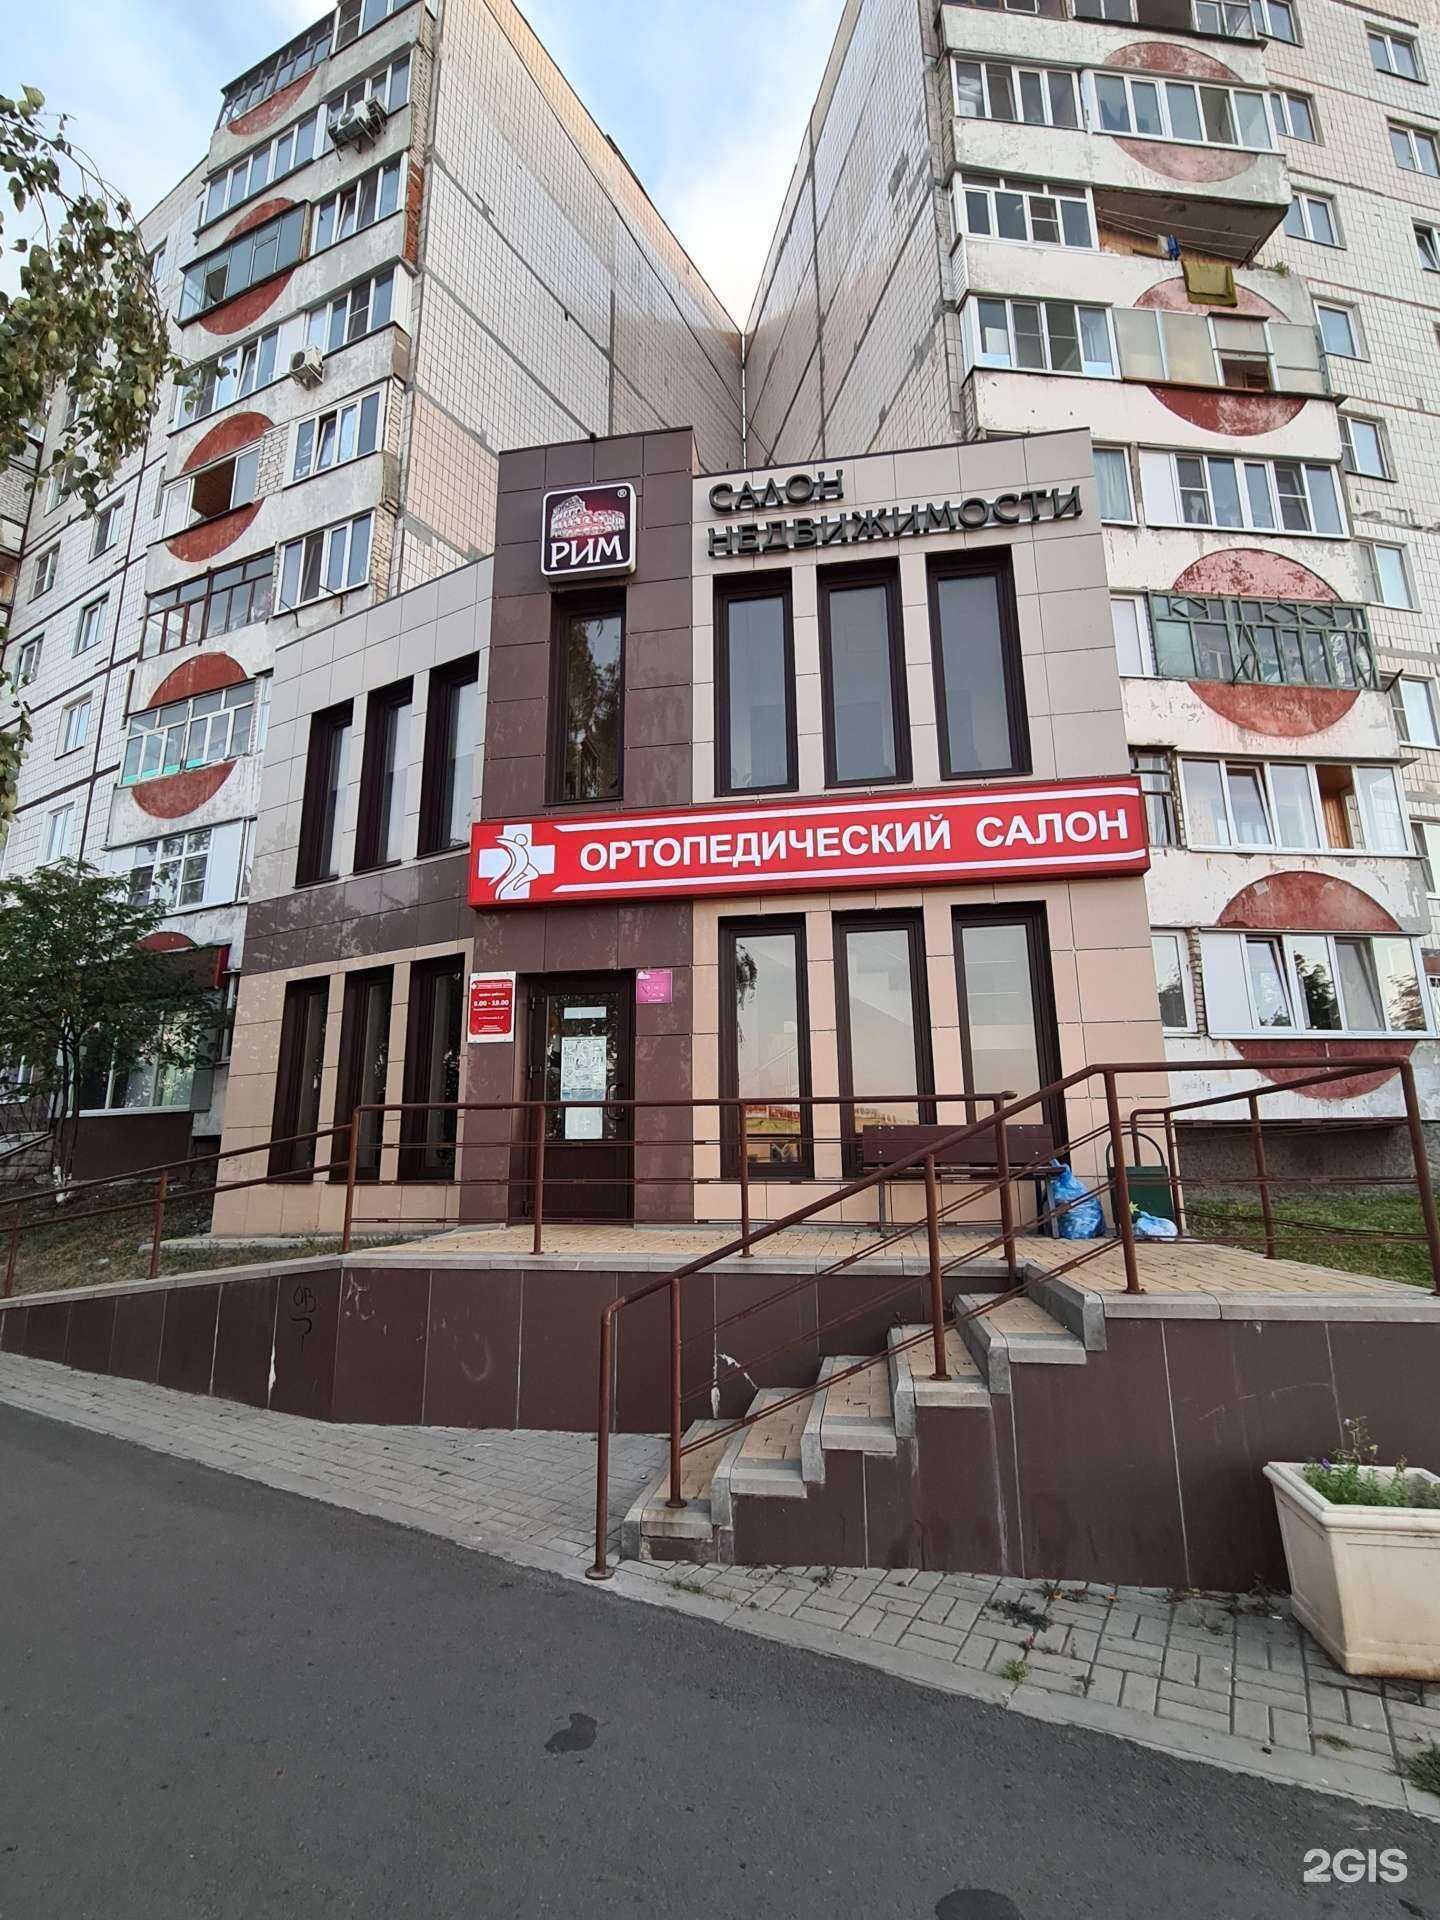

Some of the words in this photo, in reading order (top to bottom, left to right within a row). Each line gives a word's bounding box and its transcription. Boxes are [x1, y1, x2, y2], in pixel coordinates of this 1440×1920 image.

[708, 469, 845, 515] САЛОН
[707, 485, 1083, 558] НЕДВИЖИМОСТИ
[550, 535, 624, 568] РИМ
[579, 813, 952, 872] ОРТОПЕДИЧЕСКИЙ
[975, 808, 1128, 848] САЛОН
